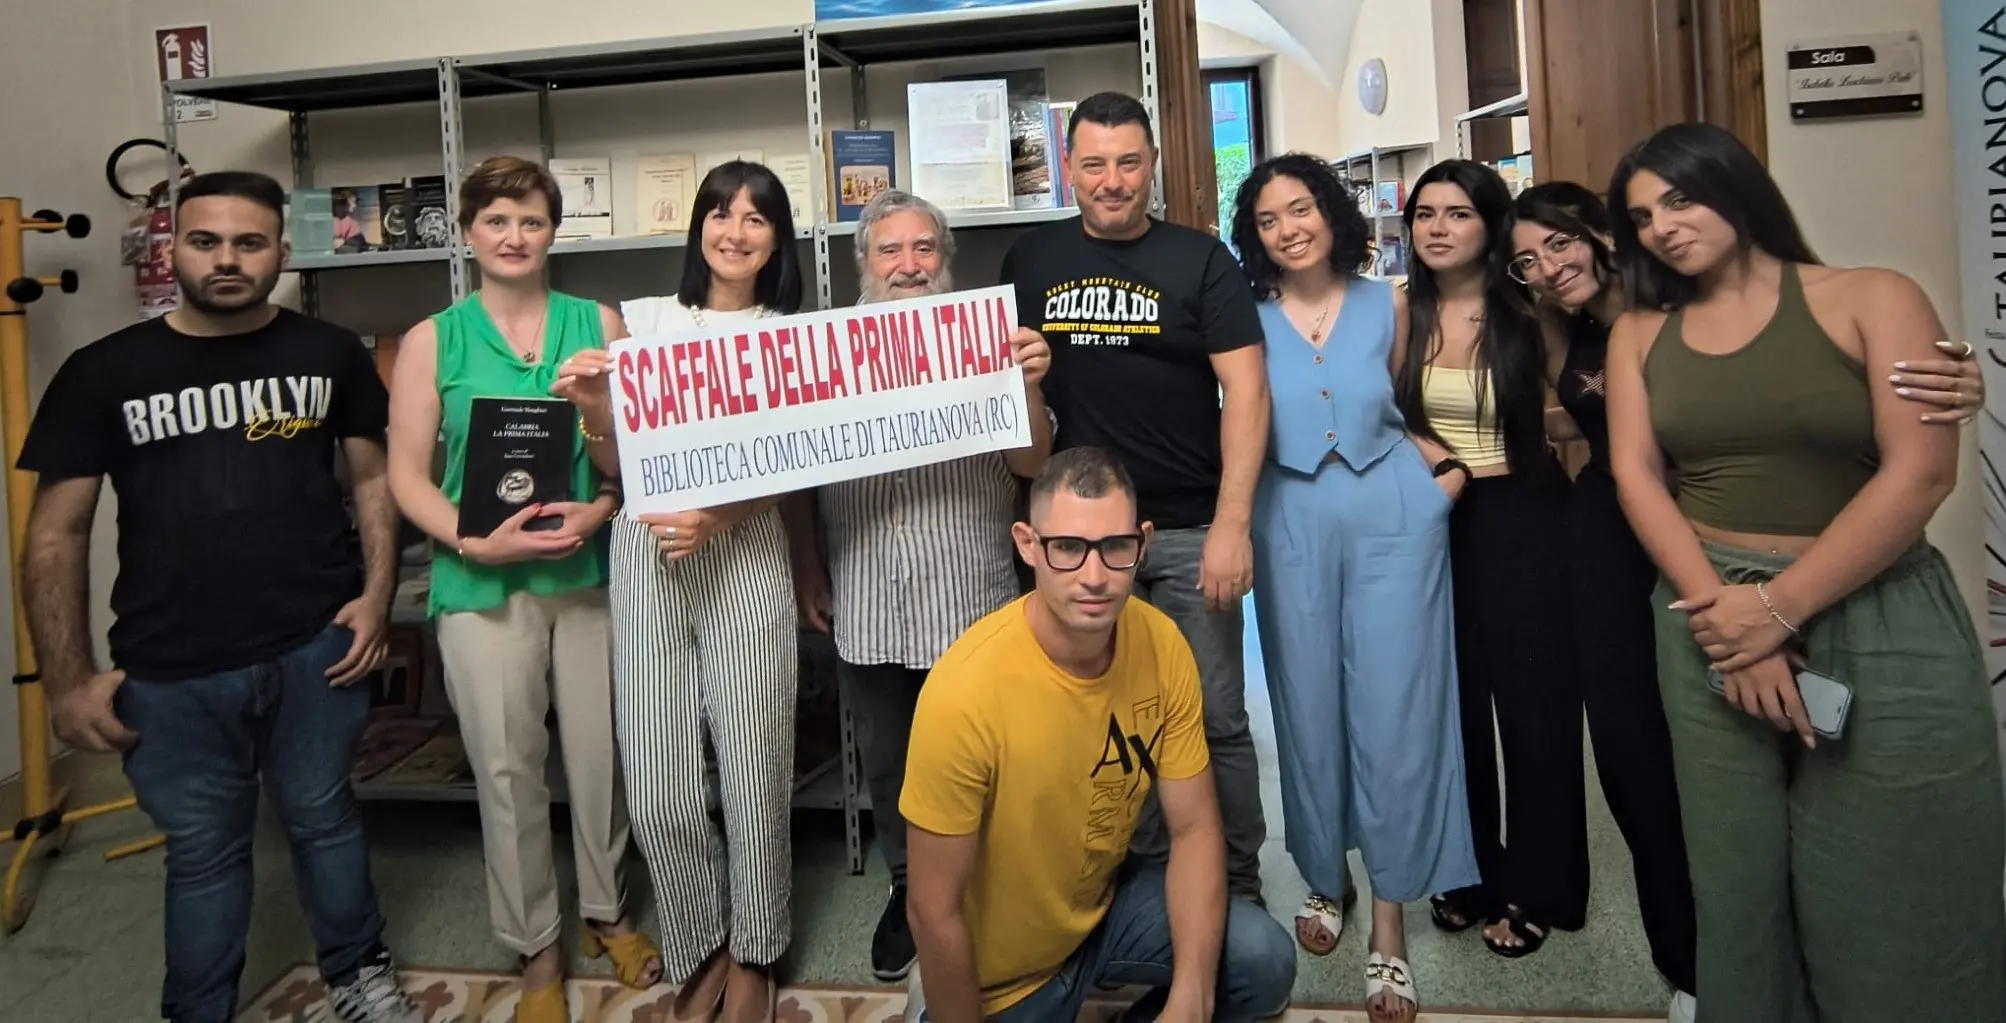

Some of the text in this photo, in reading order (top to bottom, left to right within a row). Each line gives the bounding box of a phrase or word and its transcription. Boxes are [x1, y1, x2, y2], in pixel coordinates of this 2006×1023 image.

[1812, 51, 1845, 64] Sala
[1081, 277, 1131, 290] MOUNTAIN
[1135, 284, 1160, 300] CLUB
[1045, 286, 1158, 322] COLORADO
[1070, 333, 1130, 346] DEPT. 1973
[1090, 324, 1122, 333] COLORADO
[618, 296, 1014, 433] SCAFFALE DELLA PRIMA ITALIA
[123, 375, 332, 446] BROOKLYN
[640, 392, 1019, 497] BIBLIOTECA COMUNALE DI TAURIANOVA (RC)
